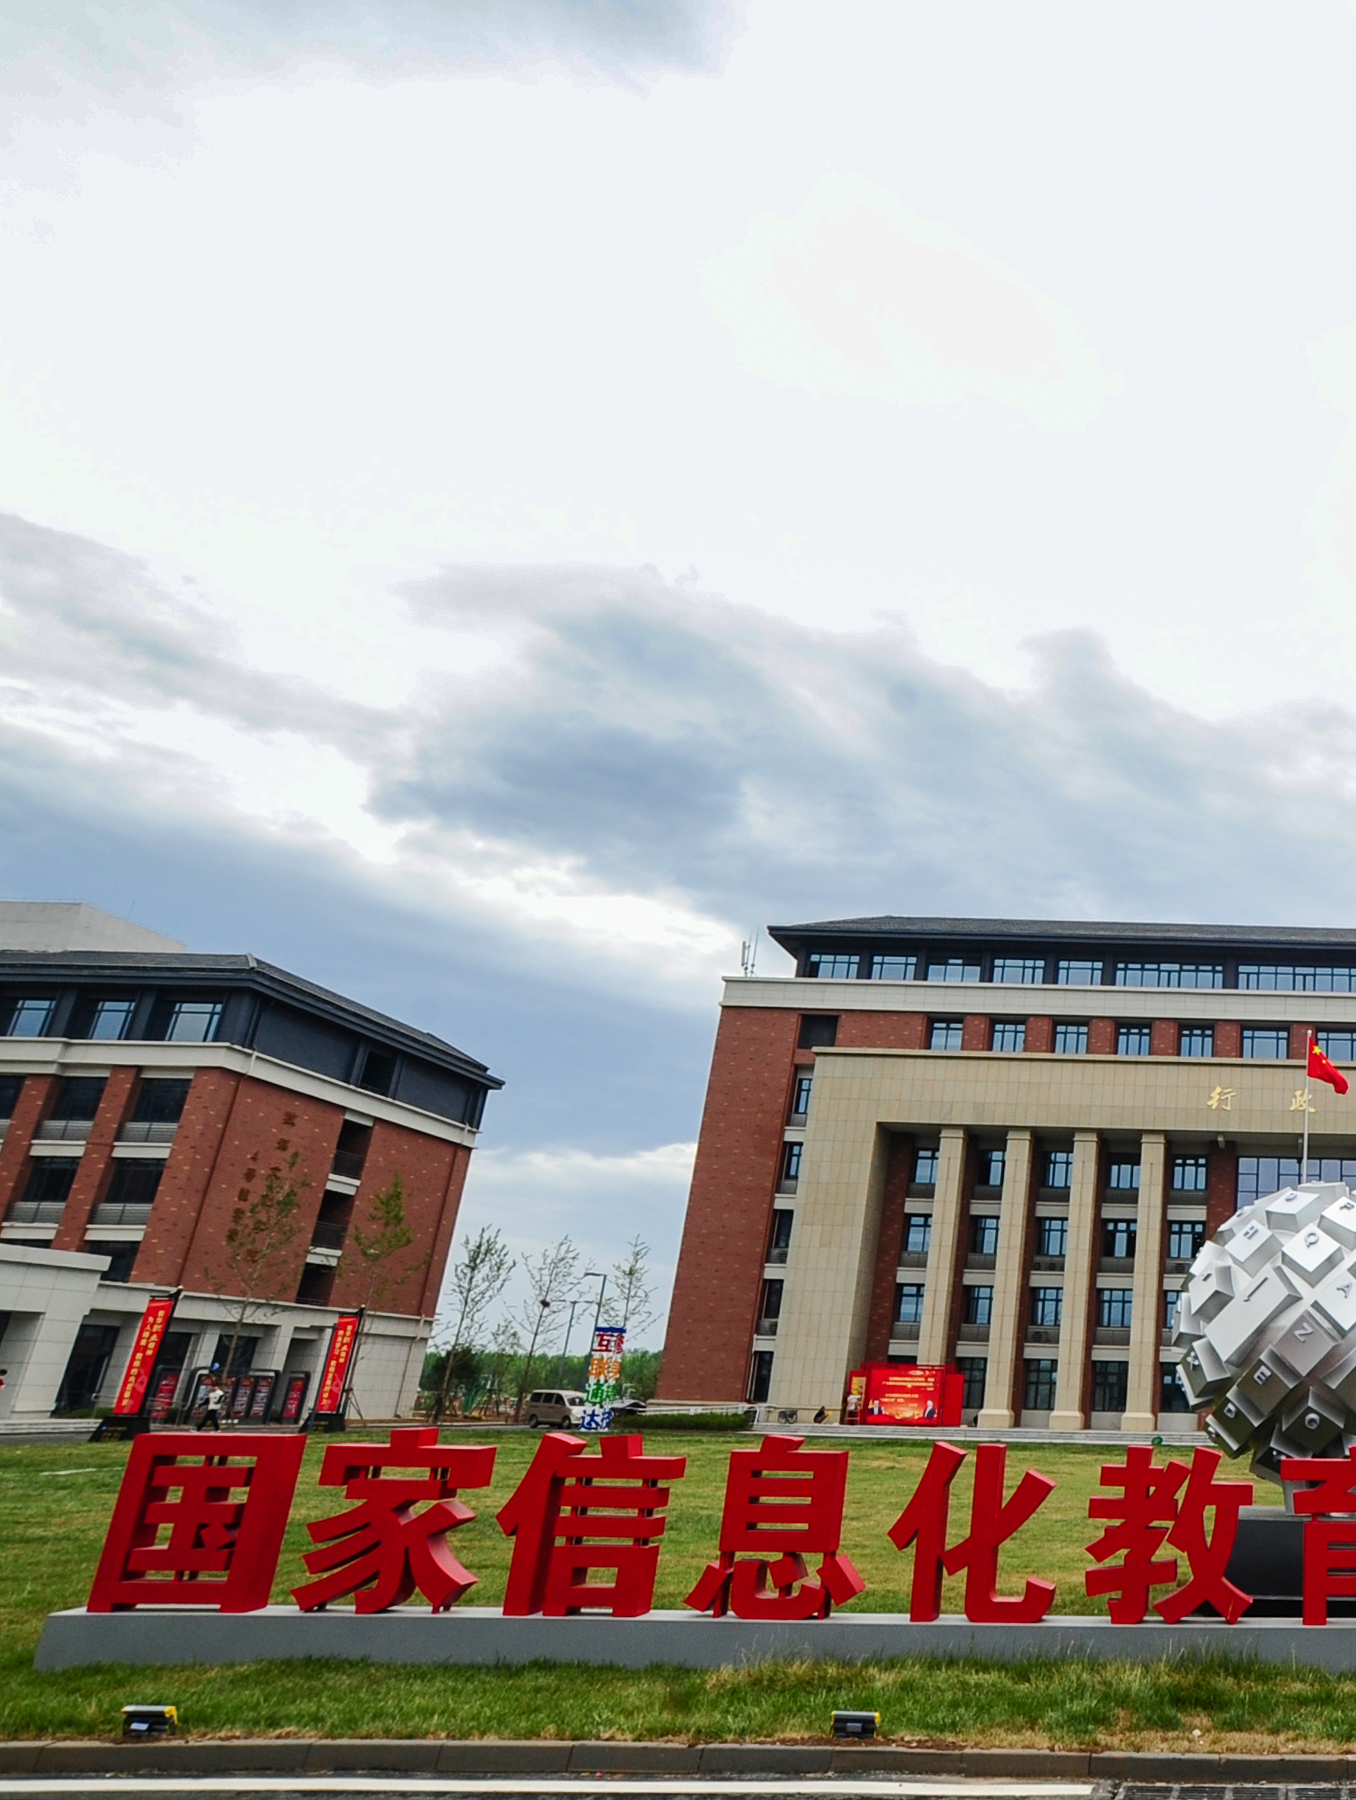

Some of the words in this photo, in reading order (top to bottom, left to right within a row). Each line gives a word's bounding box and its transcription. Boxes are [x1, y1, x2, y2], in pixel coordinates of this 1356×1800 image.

[1336, 1281, 1353, 1299] A
[1293, 1322, 1314, 1343] Z
[579, 1333, 614, 1431] 互联通达
[1253, 1365, 1272, 1385] E
